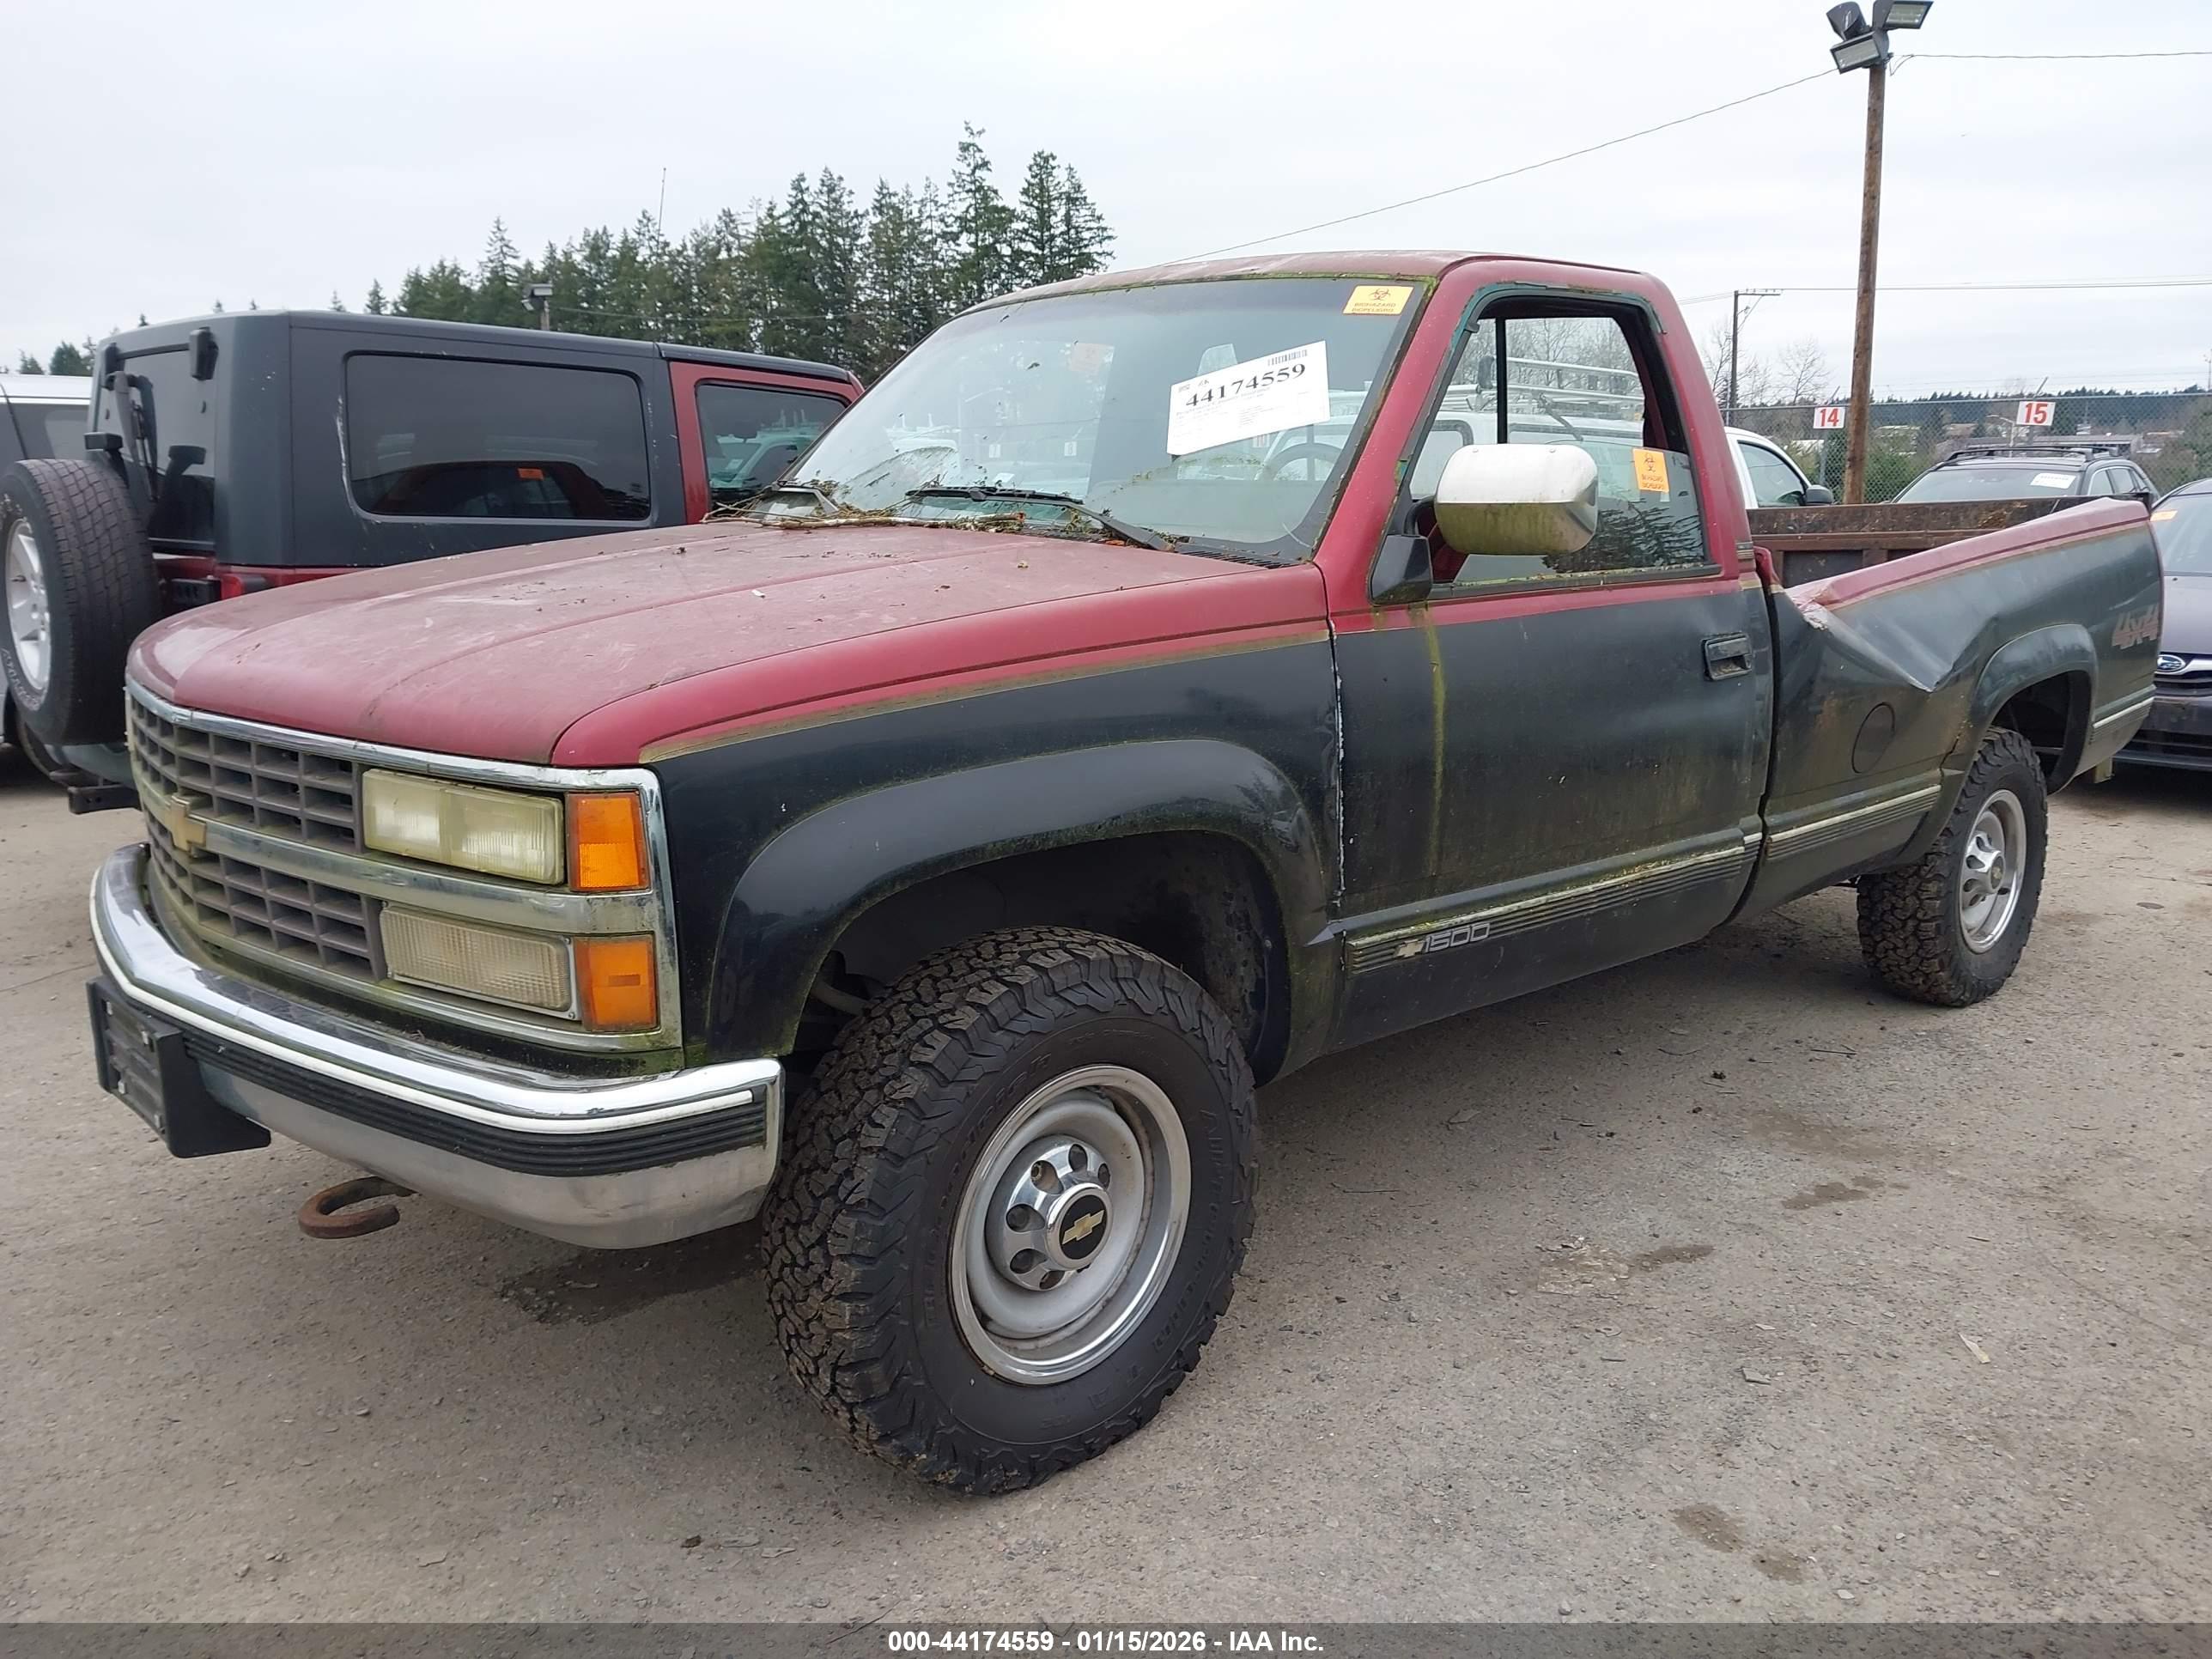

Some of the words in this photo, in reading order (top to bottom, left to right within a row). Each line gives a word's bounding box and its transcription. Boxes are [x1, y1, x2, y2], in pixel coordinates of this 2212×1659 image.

[1185, 363, 1306, 407] 44174559
[1820, 408, 1839, 427] 14
[2025, 402, 2048, 424] 15
[1424, 921, 1491, 953] 1500
